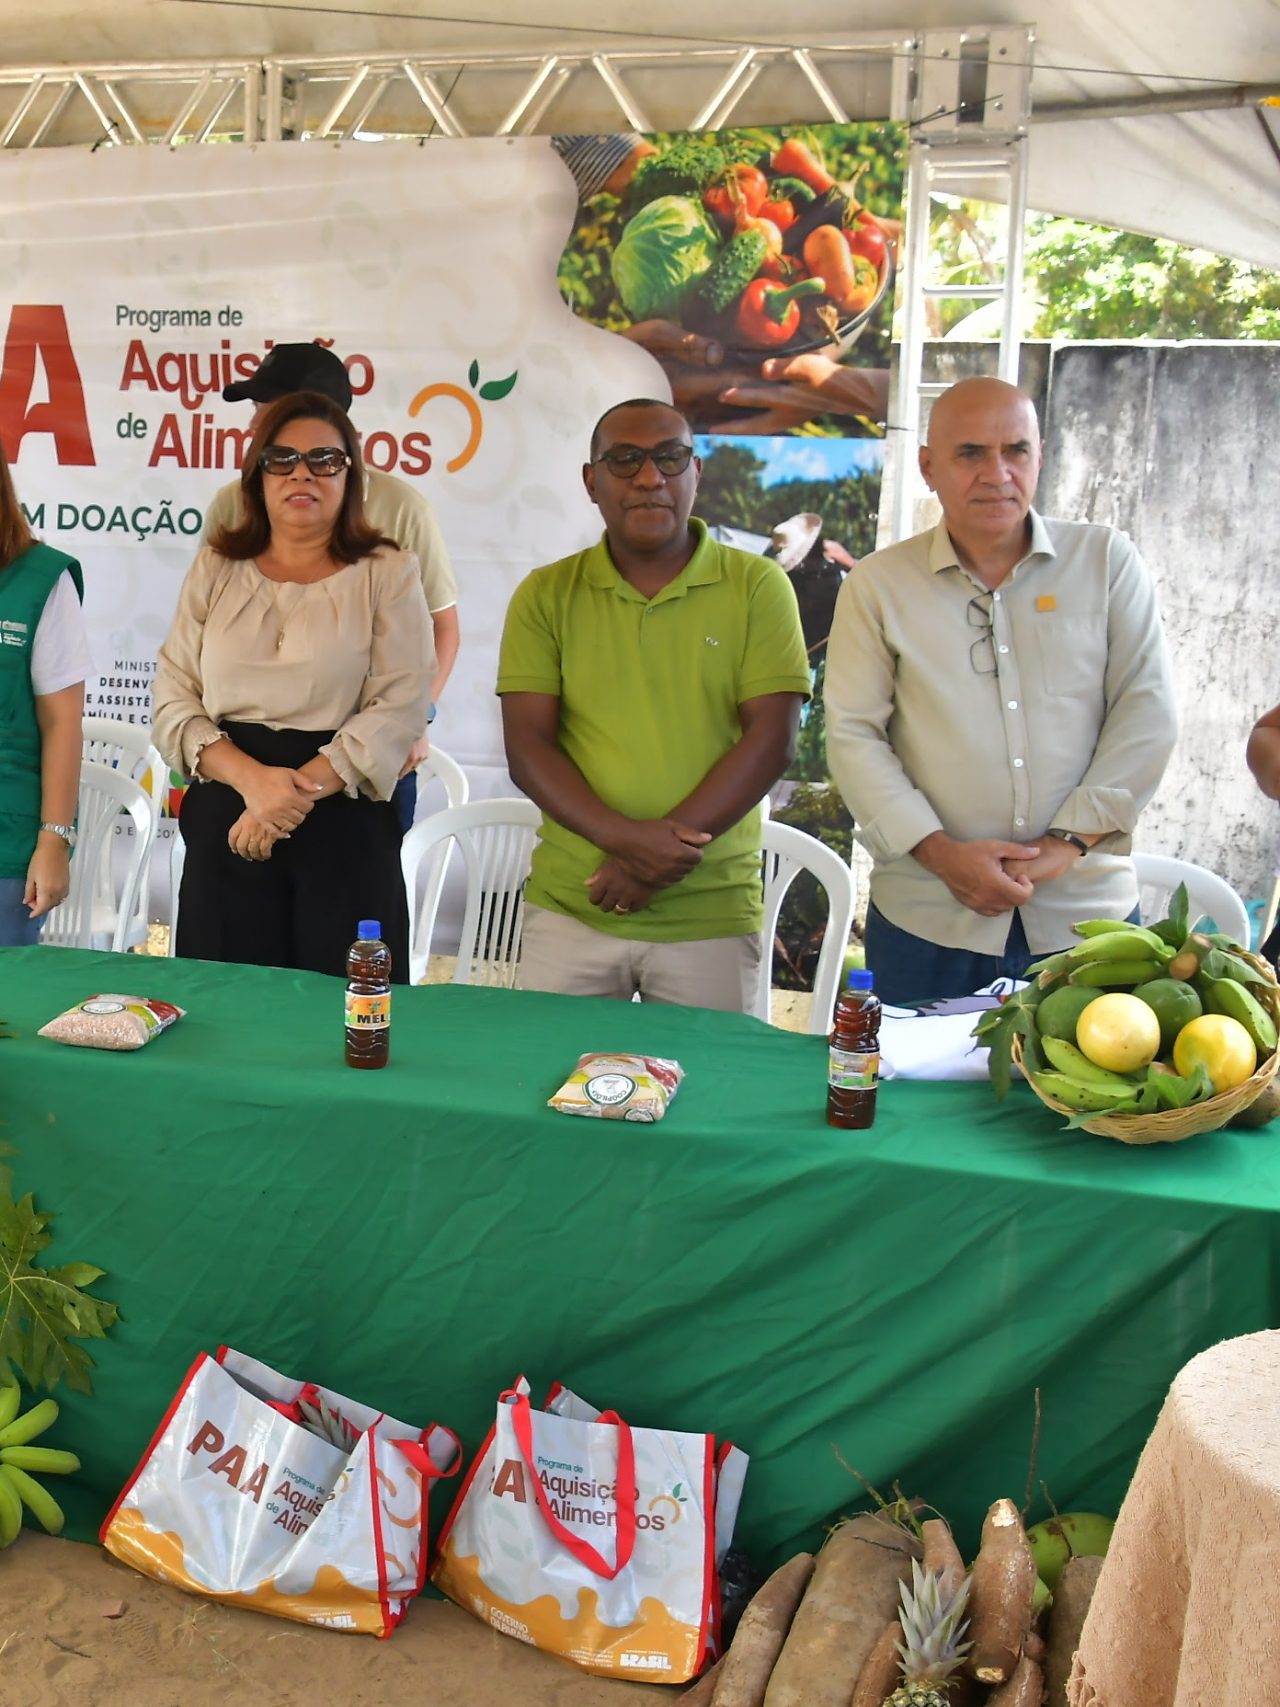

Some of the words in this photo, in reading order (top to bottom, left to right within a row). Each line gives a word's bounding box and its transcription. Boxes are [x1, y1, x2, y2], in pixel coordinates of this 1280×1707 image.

[116, 305, 211, 332] Programa
[217, 305, 243, 326] de
[119, 338, 374, 410] Aquiso
[116, 412, 147, 438] de
[148, 413, 432, 476] Alimos
[57, 500, 202, 541] DOAÇÃO
[114, 659, 158, 673] MINIST
[99, 677, 154, 689] DESENV
[86, 693, 92, 703] E
[97, 694, 151, 707] ASSISTÊ
[128, 714, 135, 724] E
[357, 1014, 385, 1023] MEL
[186, 1419, 269, 1504] PAA
[538, 1456, 572, 1472] Programa
[573, 1464, 583, 1473] de
[283, 1467, 315, 1490] Programa
[316, 1484, 325, 1495] de
[266, 1502, 279, 1514] de
[549, 1498, 665, 1531] Alimenos
[620, 1653, 672, 1670] BRASIL
